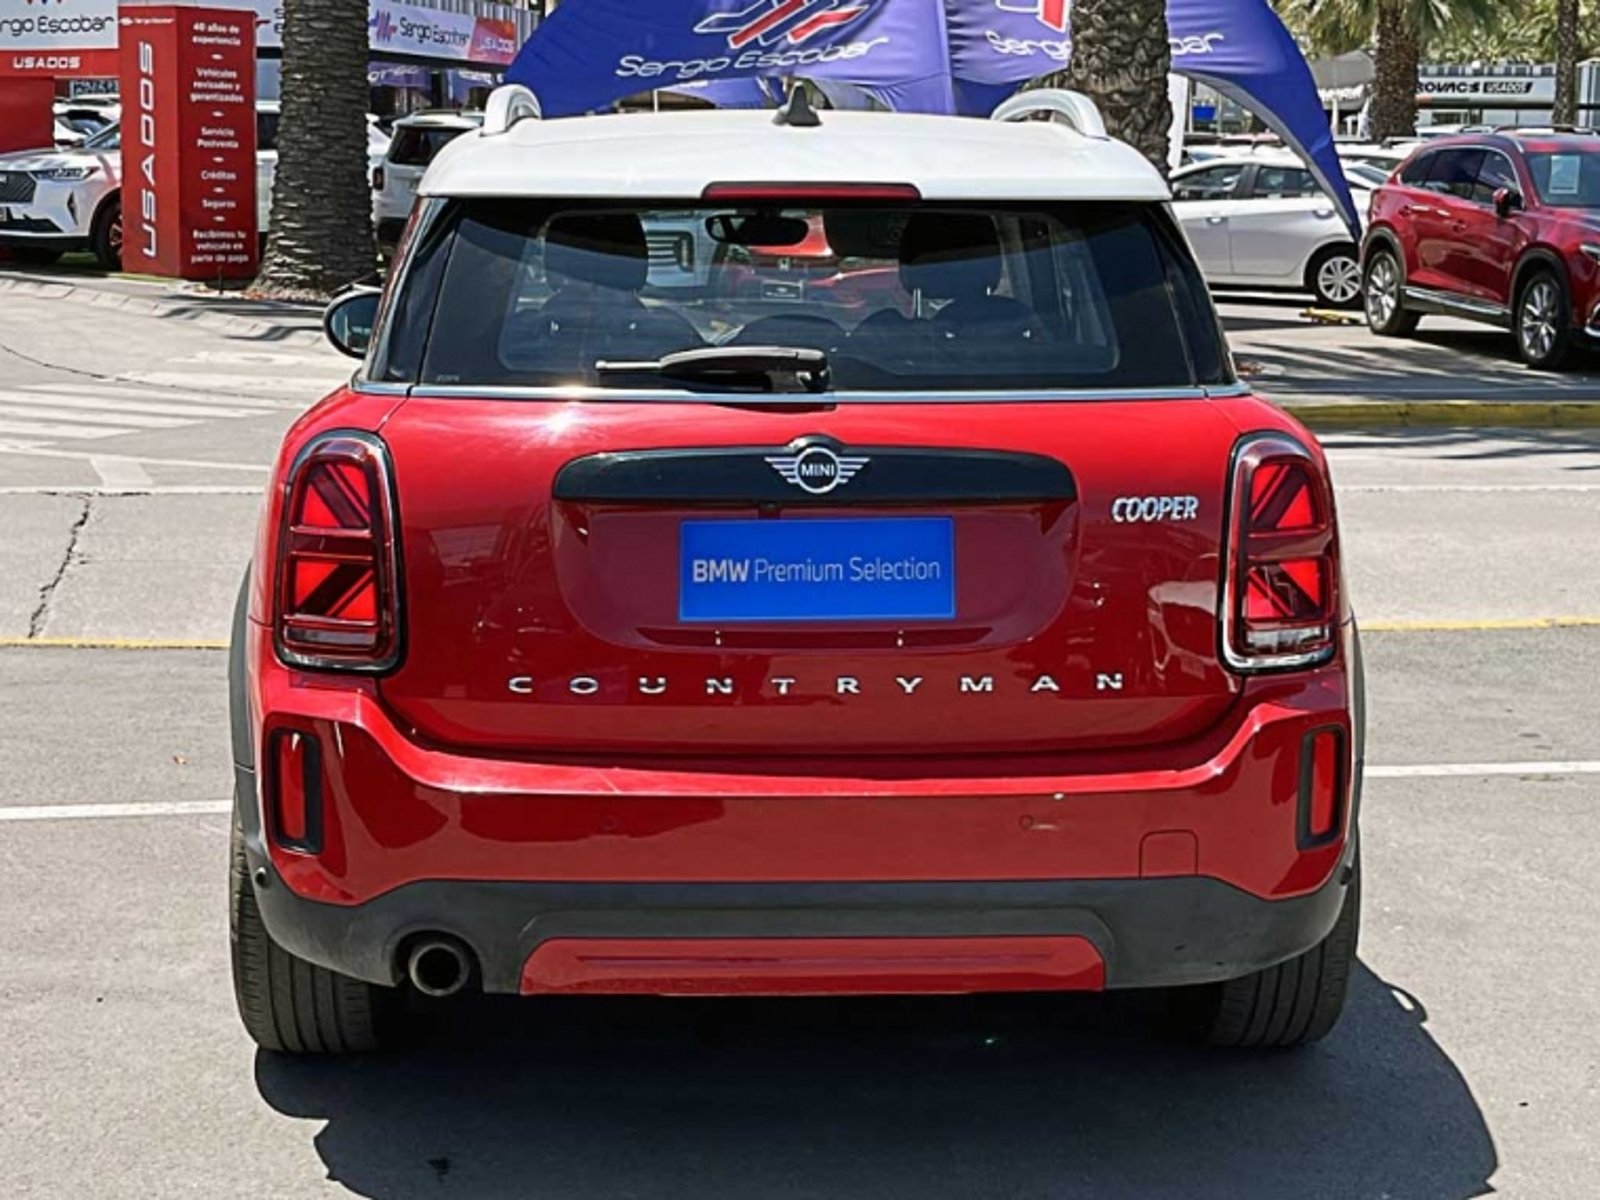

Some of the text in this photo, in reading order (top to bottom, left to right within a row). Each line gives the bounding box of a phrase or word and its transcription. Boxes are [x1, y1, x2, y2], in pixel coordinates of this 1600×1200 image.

[37, 14, 114, 33] Escobar
[229, 24, 240, 34] de
[192, 35, 241, 46] experiencia
[734, 37, 889, 68] Escobar
[12, 55, 81, 69] USADOS
[193, 81, 233, 91] revisados
[190, 92, 244, 103] garantizados
[201, 126, 235, 137] Servicio
[197, 138, 239, 149] Postventa
[139, 41, 157, 258] USADOS
[202, 199, 236, 209] Seguros
[193, 229, 236, 239] Recibimos
[215, 253, 226, 262] de
[801, 463, 835, 477] MINI
[1111, 496, 1199, 522] COOPER
[692, 556, 940, 582] BMW Premium Selection
[508, 673, 1123, 694] COUNTRYMAN
